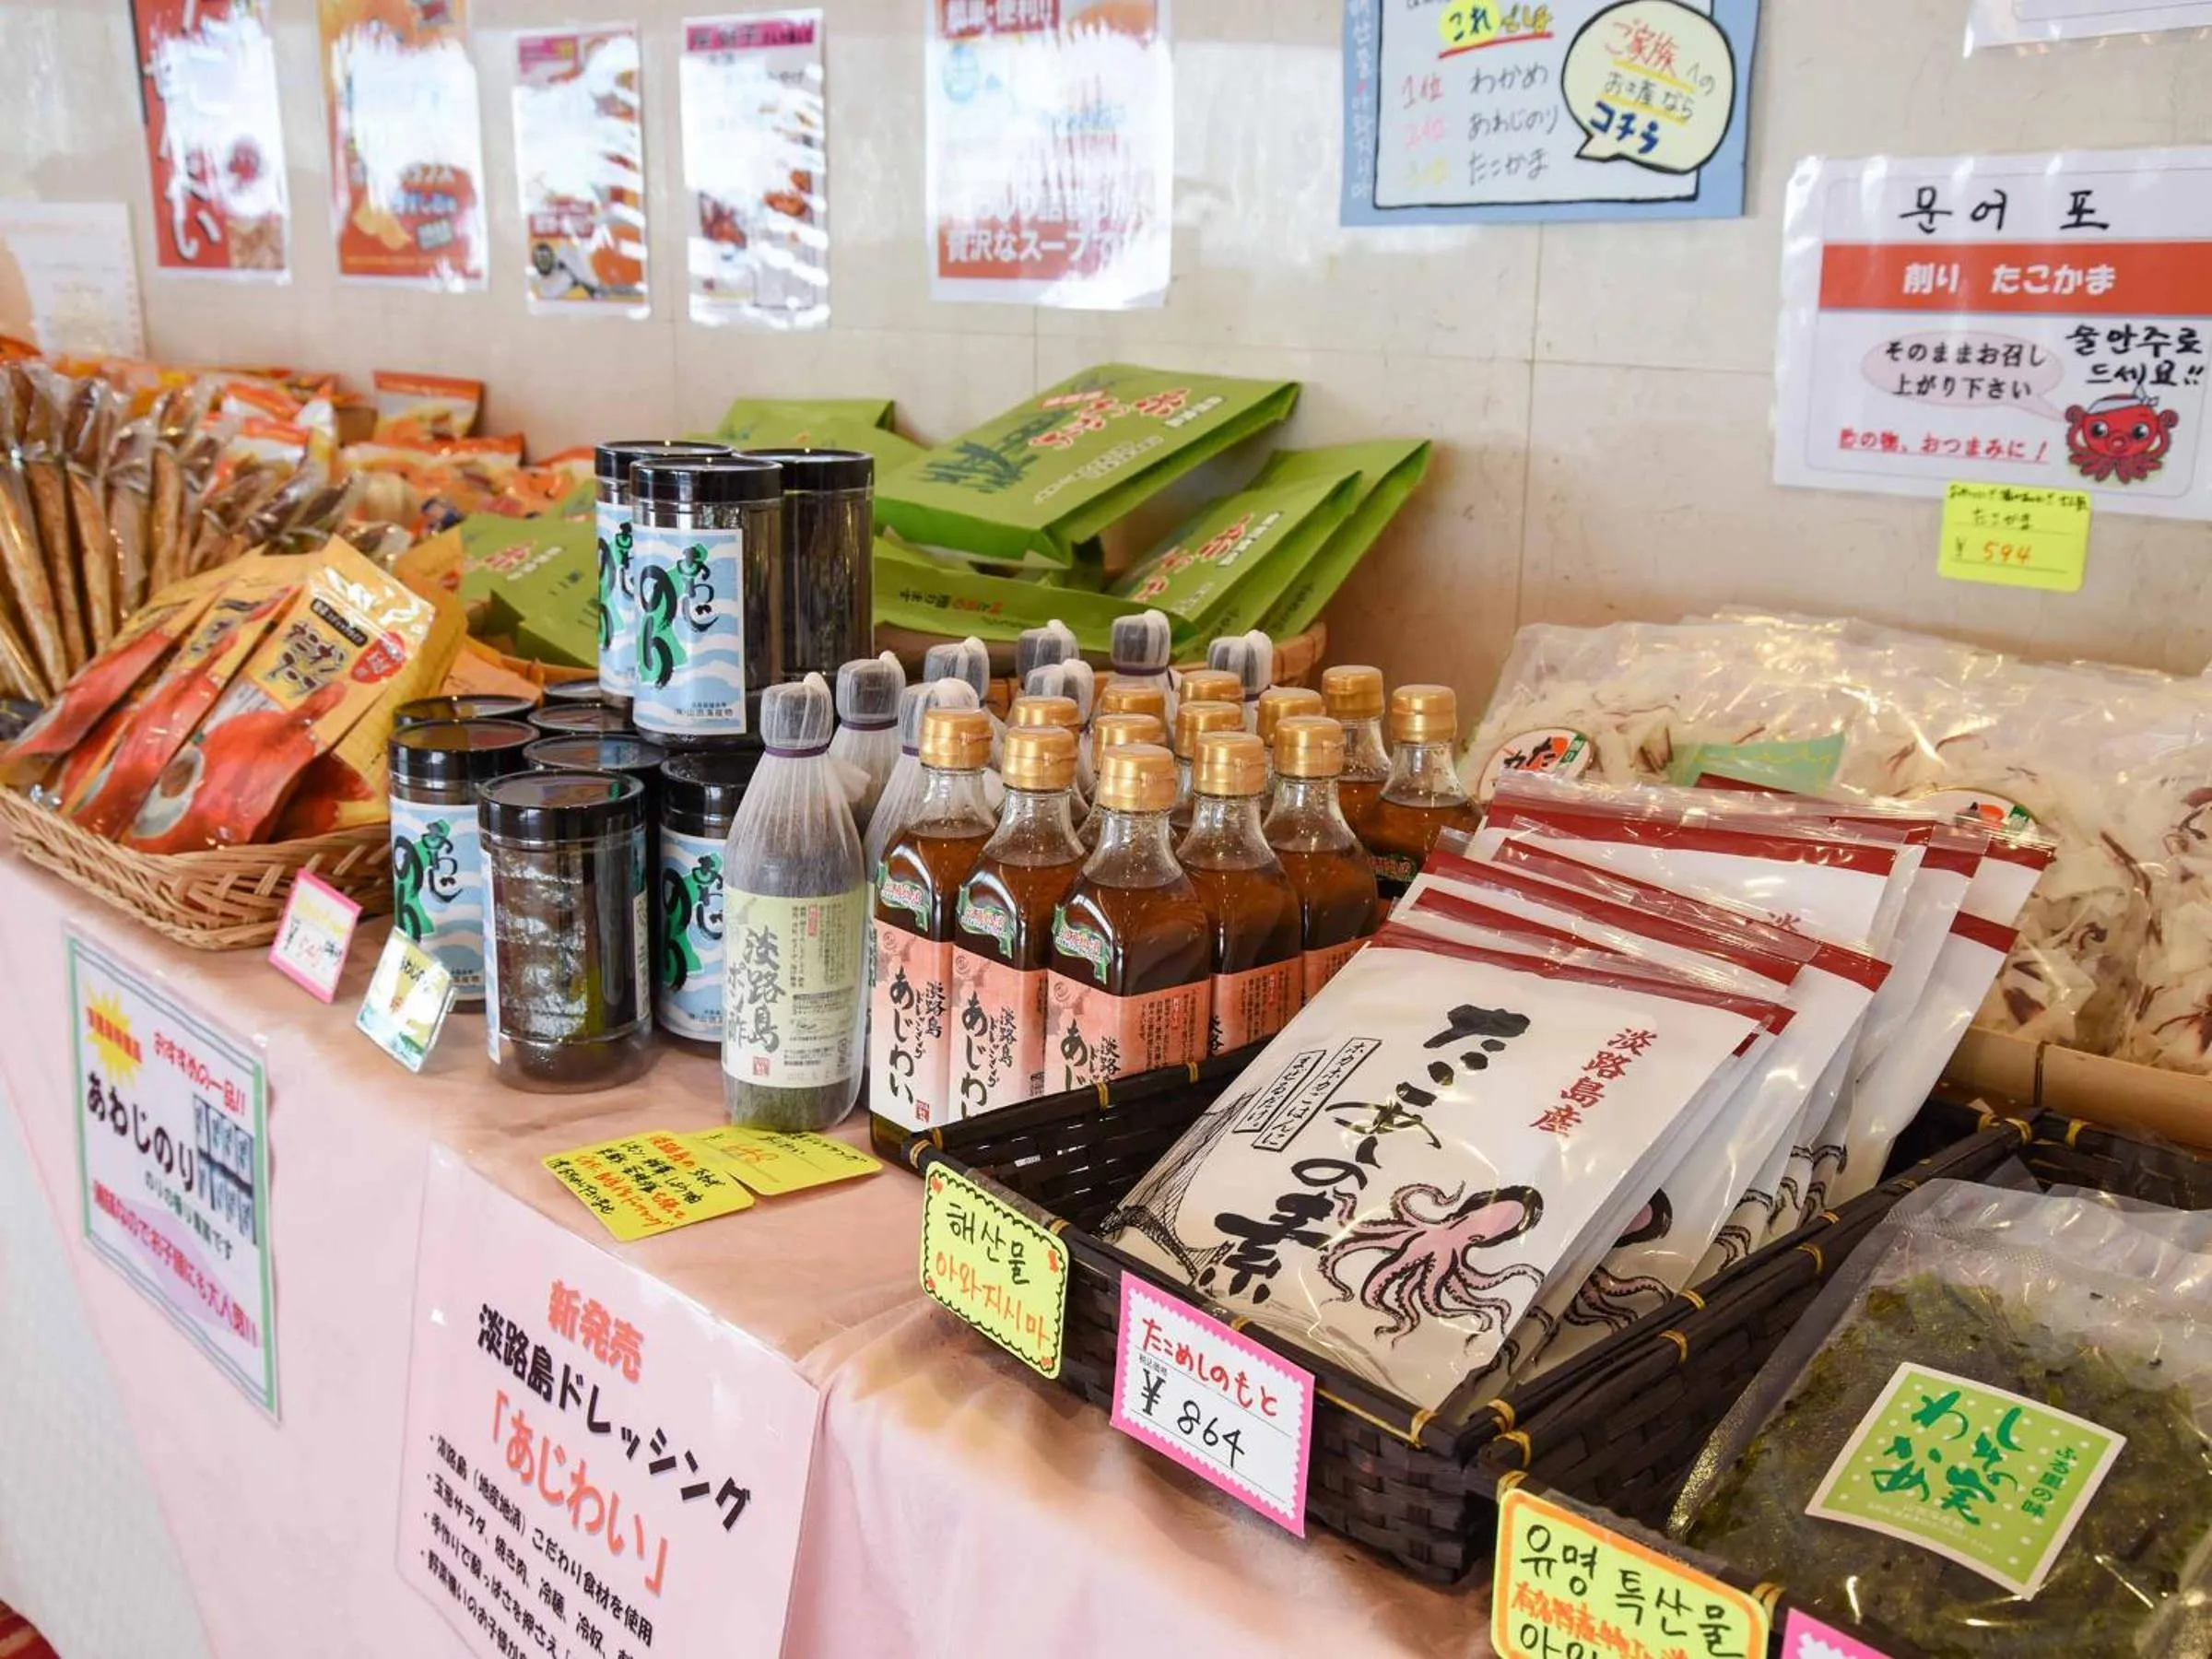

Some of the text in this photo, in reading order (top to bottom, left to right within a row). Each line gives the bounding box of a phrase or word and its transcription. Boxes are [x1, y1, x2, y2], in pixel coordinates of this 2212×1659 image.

[1467, 106, 1559, 144] あわじのり
[1471, 61, 1549, 96] わかめ
[1589, 100, 1659, 155] コチラ
[1902, 263, 2116, 296] 削り たこかま
[1884, 340, 2048, 368] そのままお召し
[1893, 375, 2032, 401] 上がり下さい
[743, 924, 787, 1054] 淡路島
[889, 965, 915, 1105] あじわい
[925, 981, 947, 1040] 淡路島
[999, 1006, 1018, 1069] 淡路島
[1100, 1035, 1122, 1082] 淡路
[1262, 1042, 1366, 1146] ホカホカごはんに
[1528, 1026, 1659, 1138] 淡路島産
[86, 1071, 196, 1194] あわじのり
[1199, 1003, 1532, 1304] たこめしの素
[947, 1202, 1030, 1286] 해산물
[547, 1277, 645, 1383] 新発売
[935, 1250, 1051, 1350] 아와지시마
[477, 1302, 753, 1533] 淡路島ドレッシング
[1142, 1316, 1278, 1418] たこめしのもと
[1141, 1369, 1246, 1469] ¥ 864
[1871, 1390, 1970, 1503] わかめ
[492, 1389, 668, 1597] 「あじわい」
[1520, 1524, 1598, 1596] 유명
[1615, 1569, 1746, 1658] 특산물
